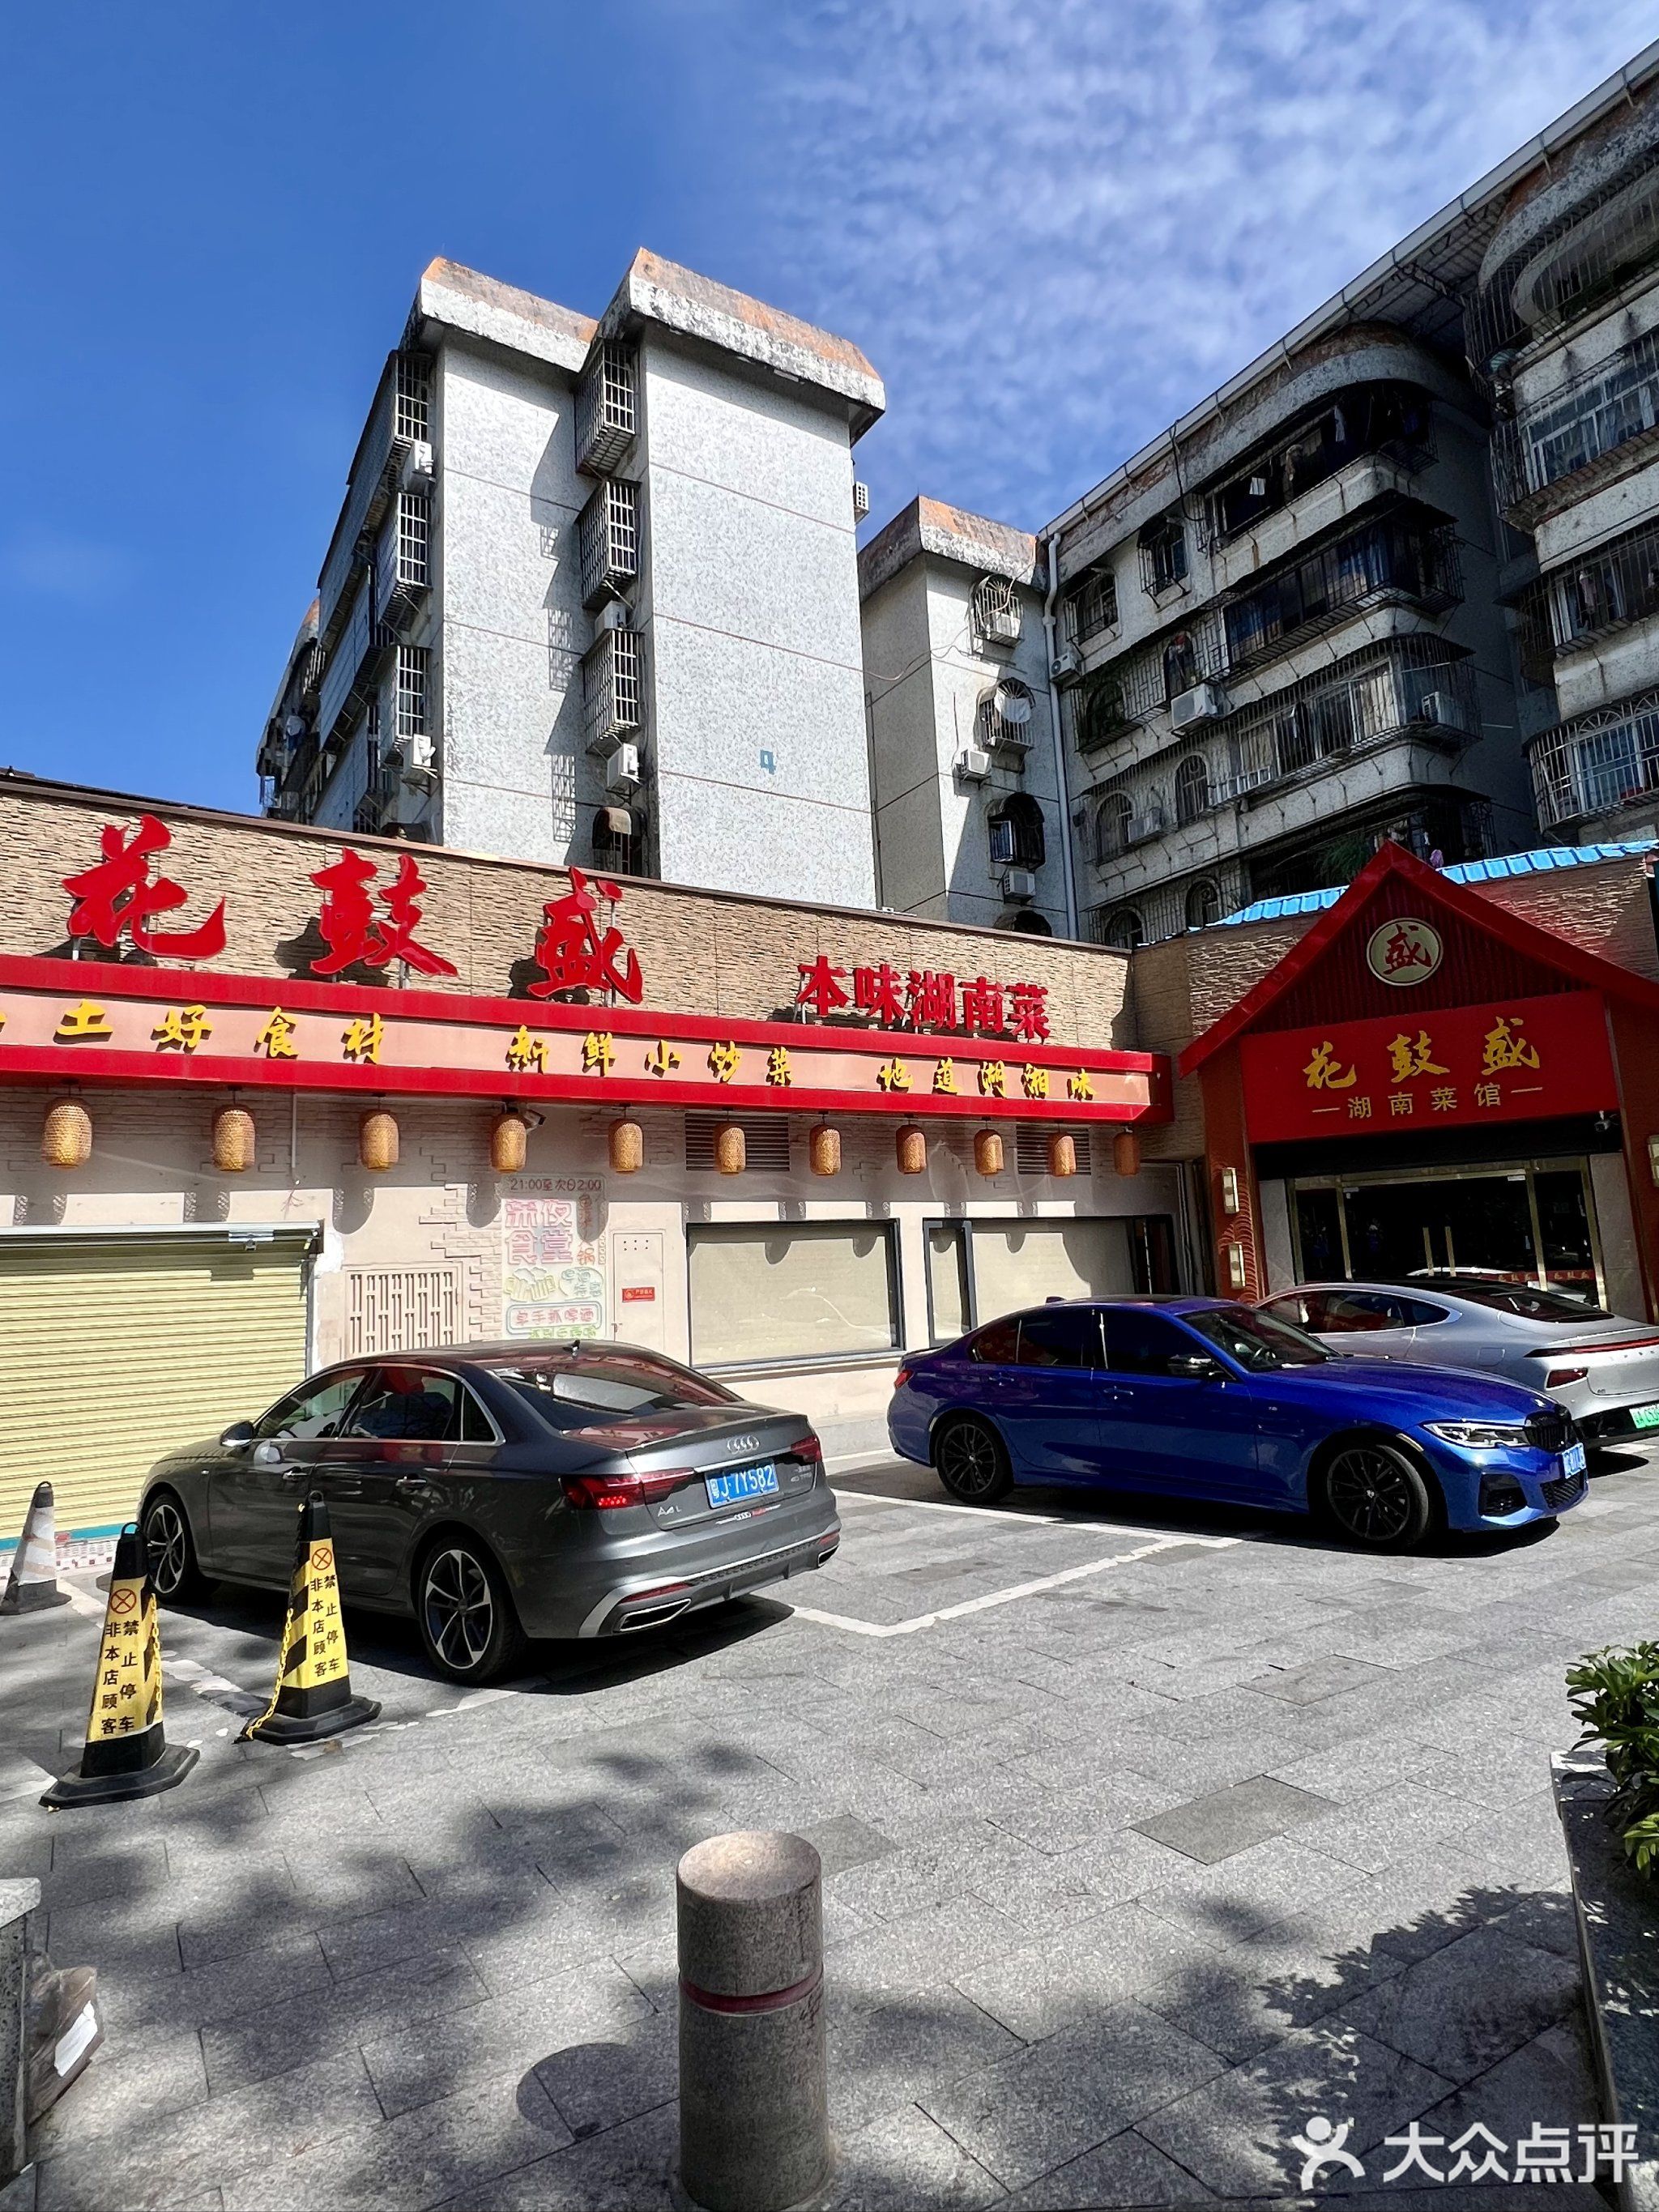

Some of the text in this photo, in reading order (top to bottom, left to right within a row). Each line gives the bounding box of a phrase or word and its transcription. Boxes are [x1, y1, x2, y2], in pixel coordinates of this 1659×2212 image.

[796, 955, 1051, 1039] 本味湖南菜
[1383, 924, 1432, 975] 盛
[0, 999, 385, 1063] 土好食材
[509, 1025, 793, 1086] 新鲜小炒菜
[310, 1578, 327, 1677] 非本店顾客
[324, 1575, 340, 1672] 禁止停车
[101, 1622, 122, 1735] 非本店顾客
[119, 1620, 139, 1732] 禁止停车
